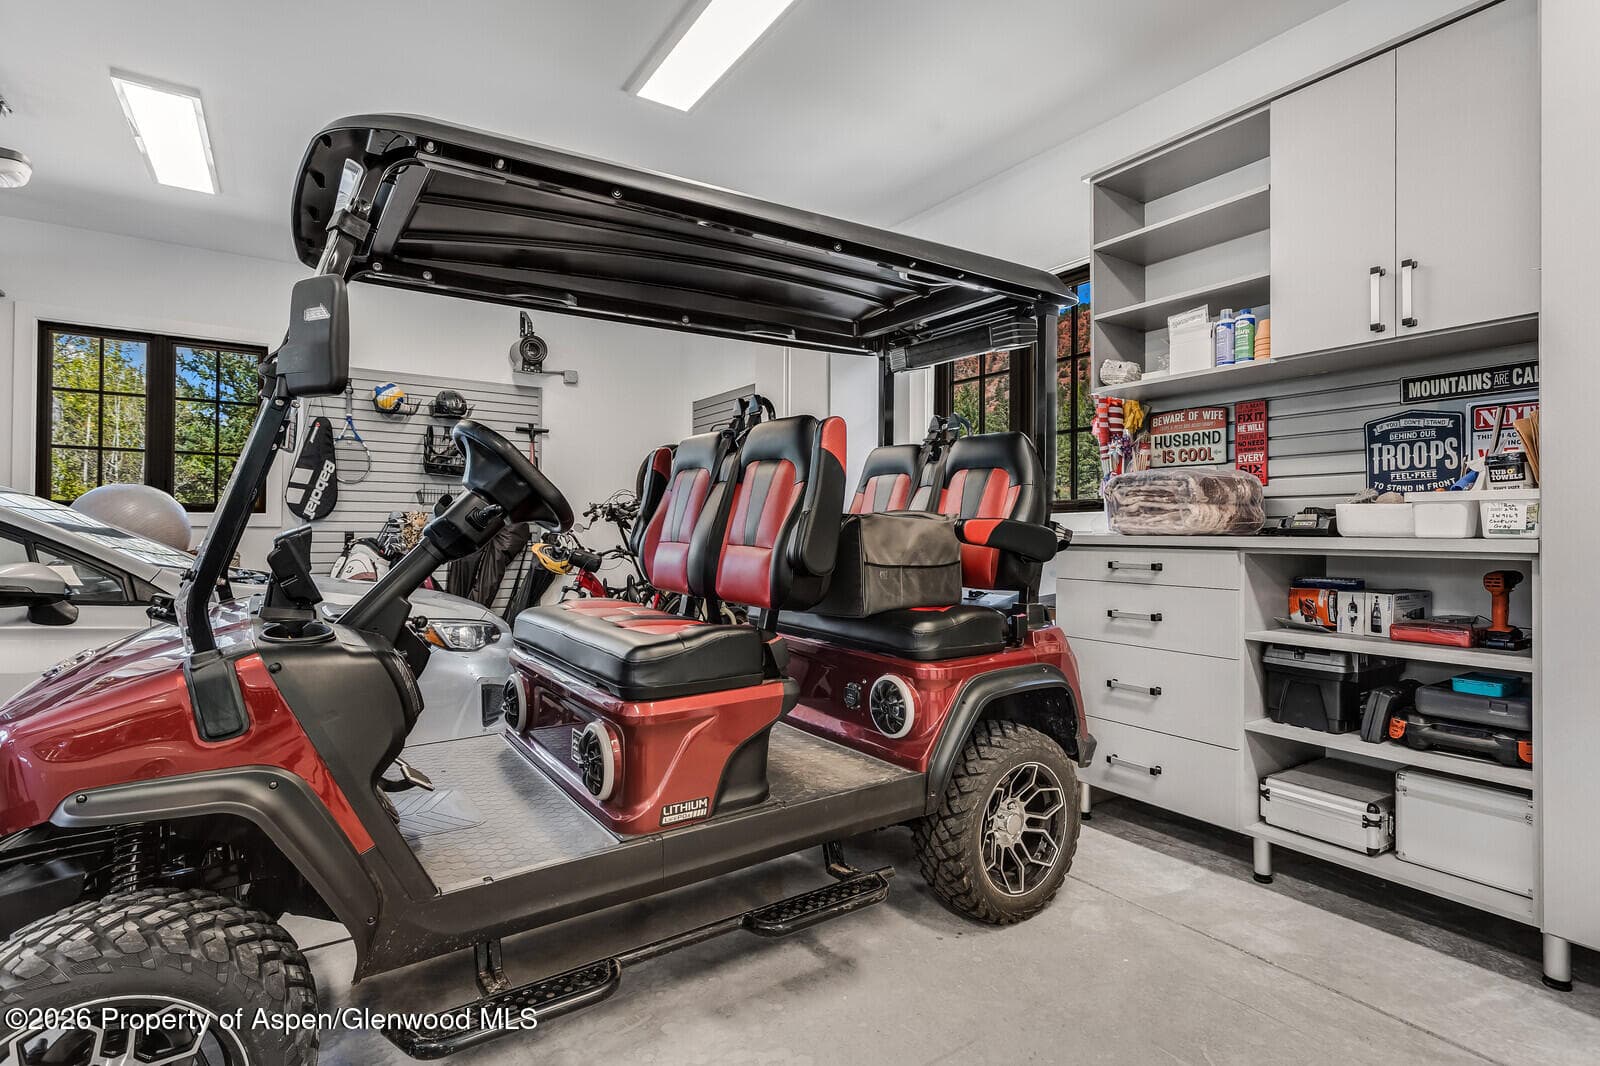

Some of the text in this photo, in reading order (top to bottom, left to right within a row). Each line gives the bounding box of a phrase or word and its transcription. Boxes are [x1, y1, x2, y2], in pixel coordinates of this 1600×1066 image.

[1409, 372, 1492, 398] MOUNTAINS
[1494, 371, 1509, 386] ARE
[1152, 413, 1185, 427] BEWARE
[1188, 411, 1199, 420] OF
[1203, 410, 1224, 420] WIFE
[1237, 413, 1253, 422] FIX
[1254, 411, 1264, 420] IT
[1237, 422, 1264, 432] HE WILL!
[1390, 430, 1437, 440] BEHIND OUR
[1154, 430, 1221, 449] HUSBAND
[1162, 447, 1214, 463] IS COOL
[1237, 453, 1264, 463] EVERY
[1370, 437, 1458, 474] TROOPS
[1374, 481, 1384, 490] TO
[1386, 484, 1413, 492] STAND
[1427, 478, 1456, 490] FRONT
[1491, 473, 1524, 481] TOWELS
[303, 459, 336, 520] Babolat
[663, 798, 708, 816] LITHIUM
